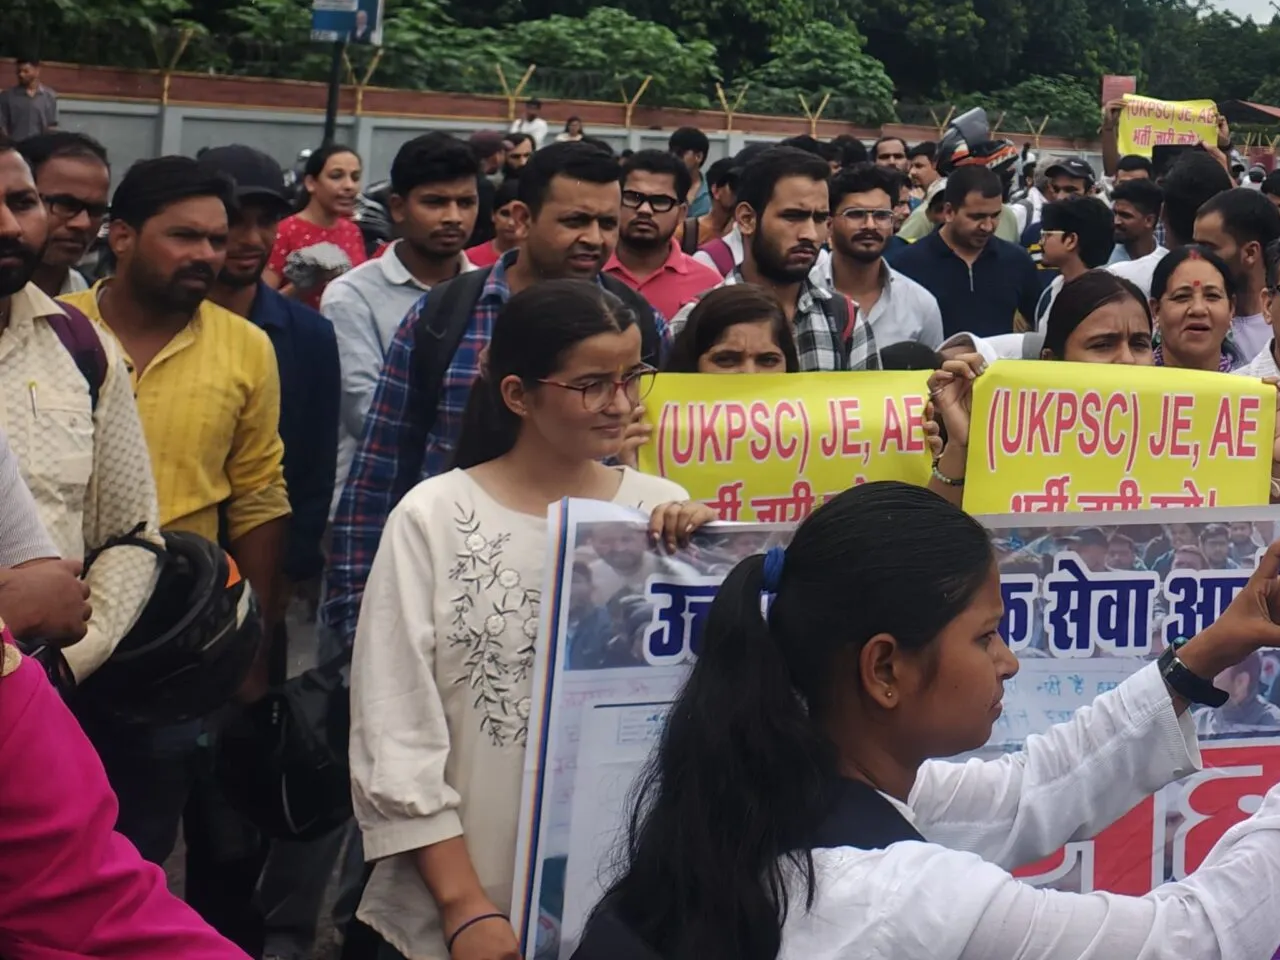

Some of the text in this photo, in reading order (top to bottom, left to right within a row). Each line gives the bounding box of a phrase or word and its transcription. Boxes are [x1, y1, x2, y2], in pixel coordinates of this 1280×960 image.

[1133, 125, 1151, 146] भर्ती
[1198, 108, 1216, 123] AE
[657, 396, 925, 478] (UKPSC) JE, AE
[987, 389, 1260, 472] (UKPSC) JE, AE
[1047, 558, 1155, 651] सेवा
